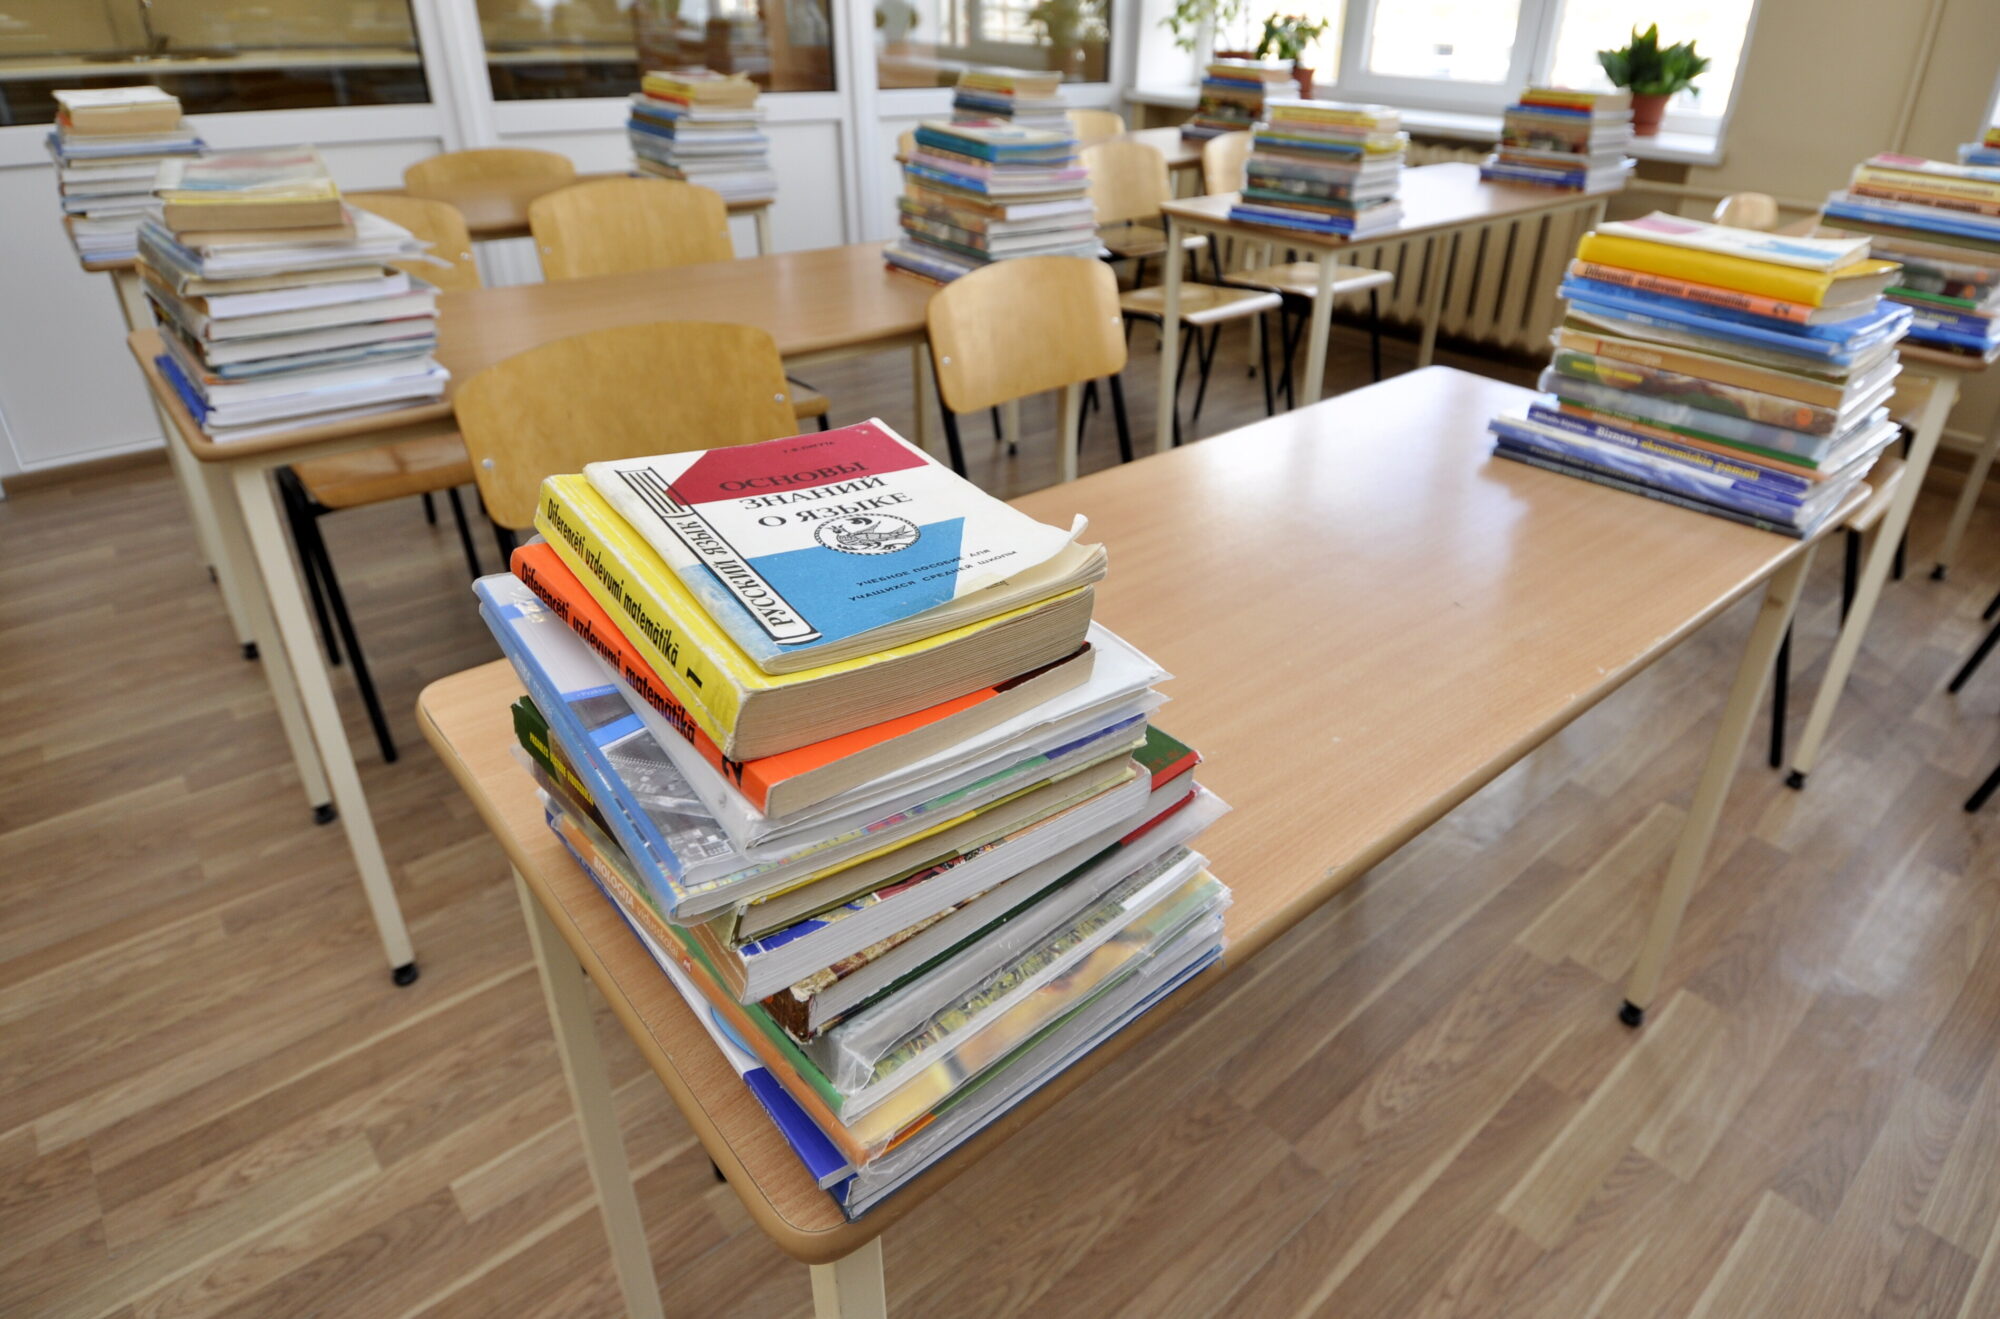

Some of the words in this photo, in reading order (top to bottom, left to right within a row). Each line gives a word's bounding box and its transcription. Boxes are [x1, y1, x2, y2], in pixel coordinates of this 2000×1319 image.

[719, 461, 869, 492] ОСНОВЫ
[739, 475, 888, 511] ЗНАНИЙ
[758, 515, 787, 527] О
[796, 492, 913, 523] ЯЗЫКЕ
[677, 520, 728, 556] ЯЗЫК
[547, 497, 586, 559] Diferencēti
[586, 551, 625, 606] uzdevumi
[624, 591, 679, 668] matemātikā
[856, 570, 912, 587] УЧЕБНОЕ
[912, 556, 964, 573] ПОСОБИЕ
[712, 559, 797, 628] РУССКИЙ
[573, 614, 622, 675] uzdevumi
[625, 665, 697, 746] matemātikā
